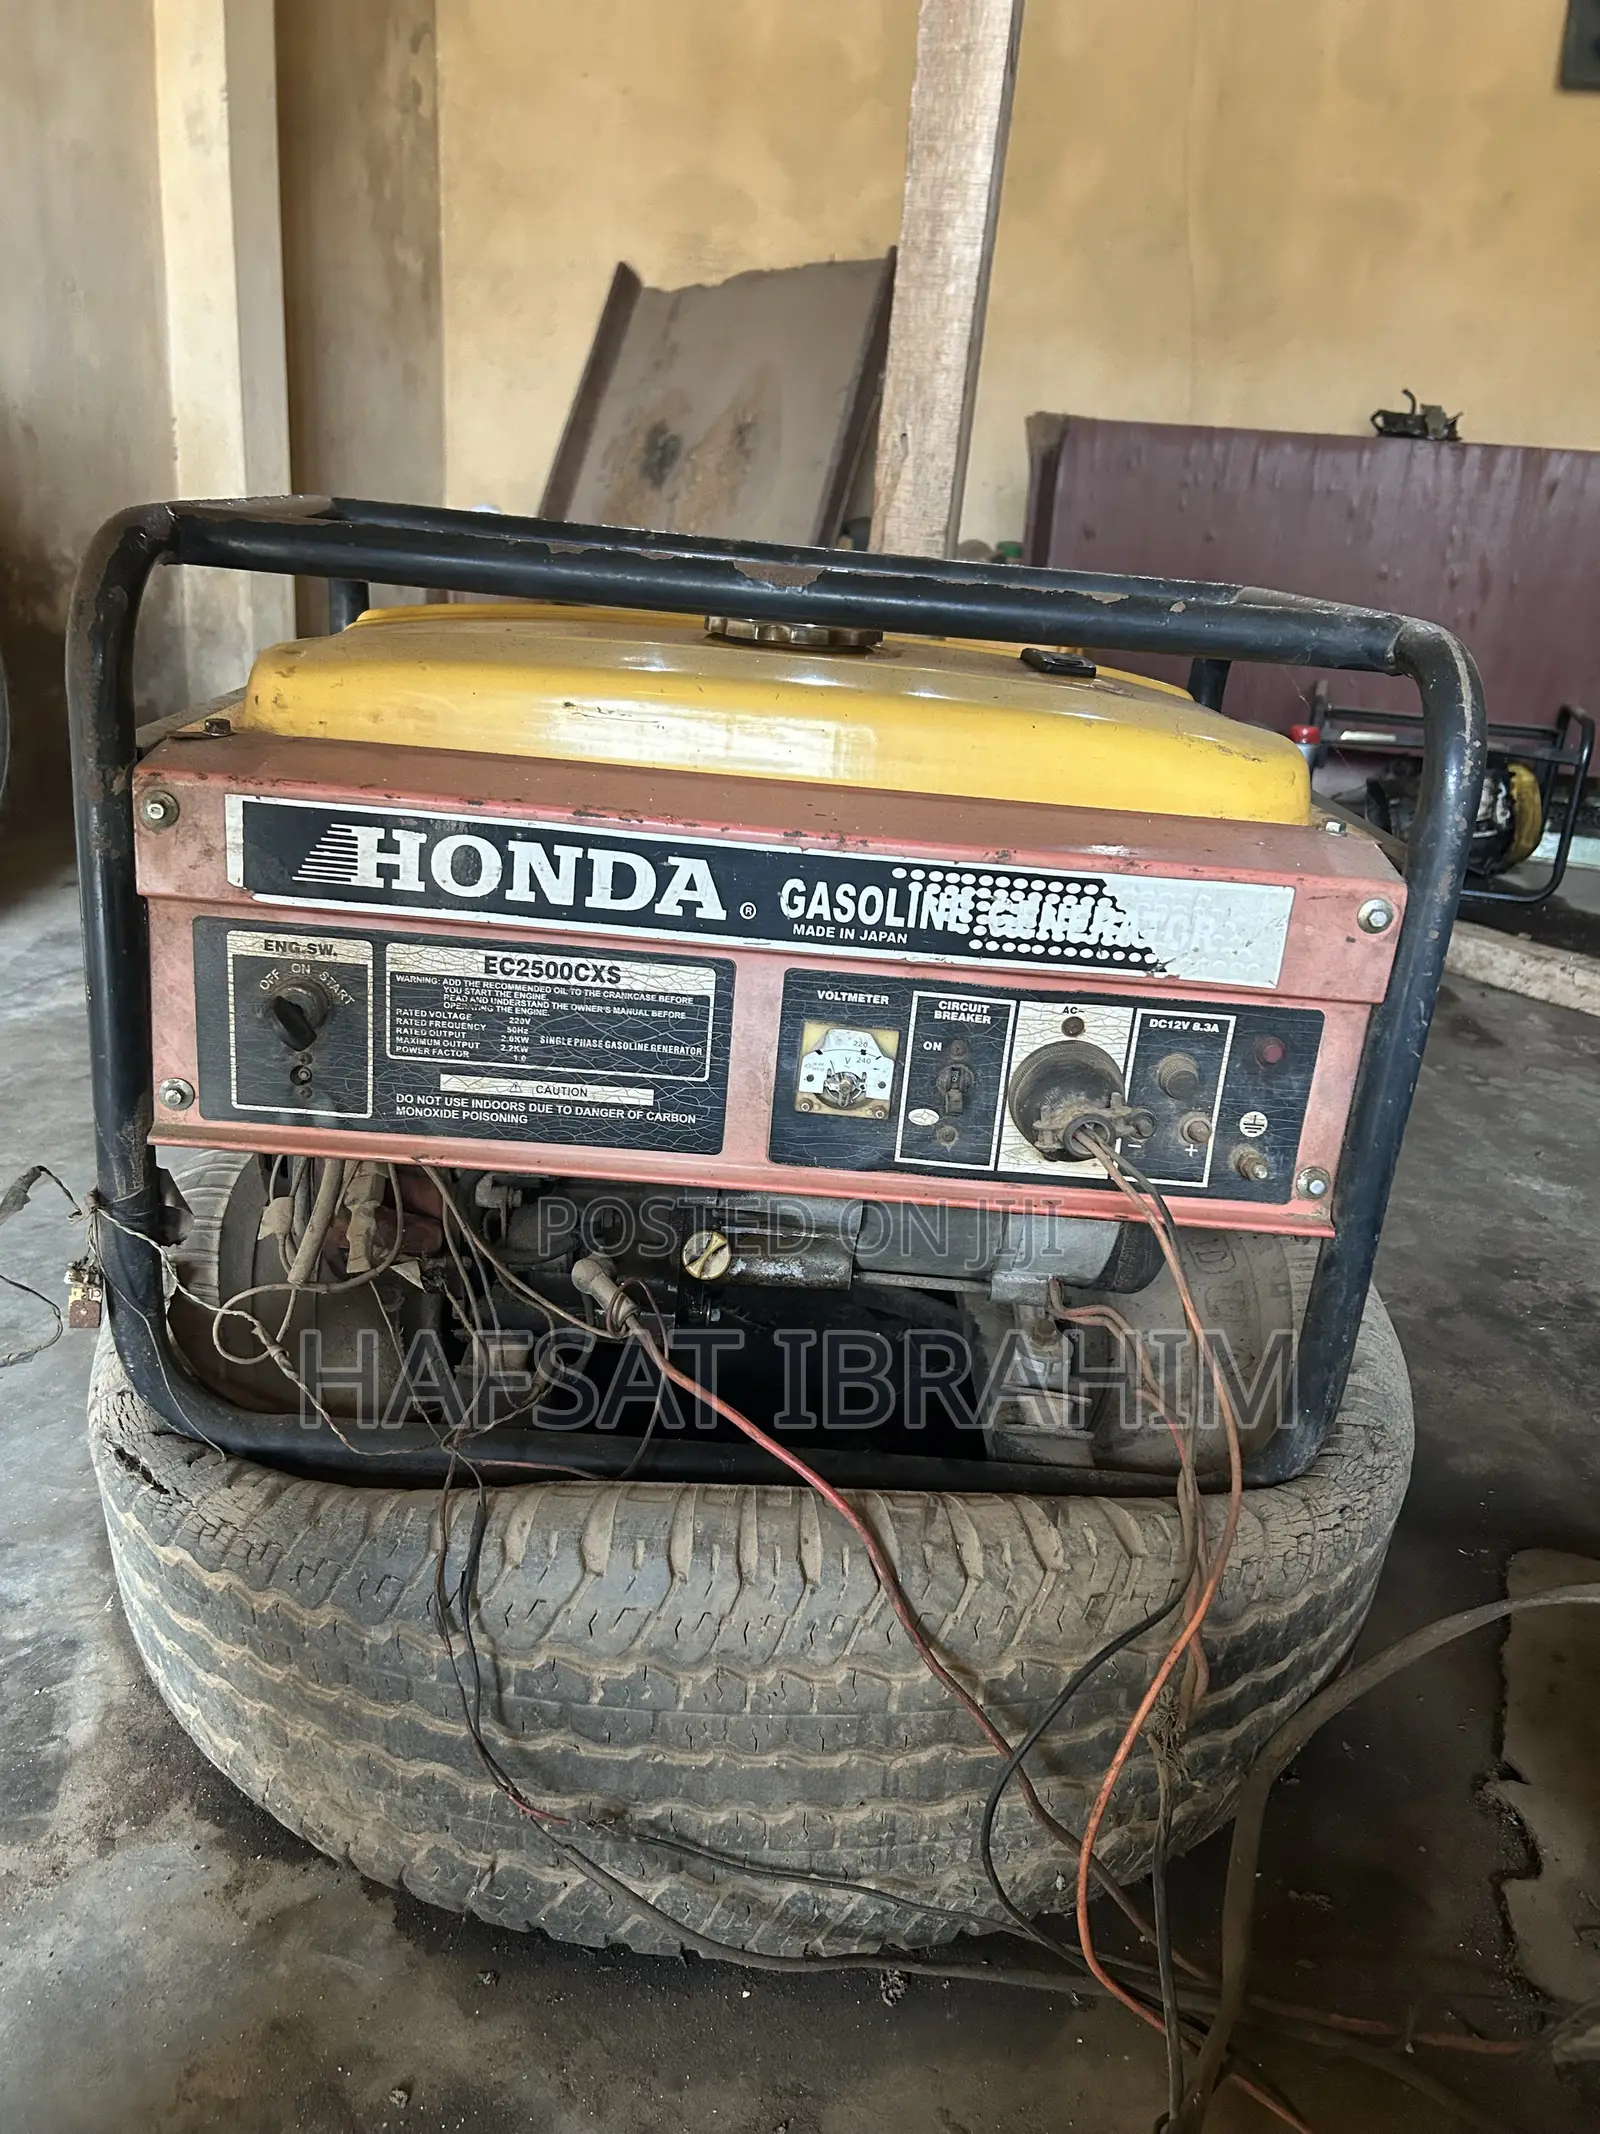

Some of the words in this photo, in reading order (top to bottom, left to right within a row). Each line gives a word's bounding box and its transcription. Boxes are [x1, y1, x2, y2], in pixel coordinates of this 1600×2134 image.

[346, 824, 727, 921] HONDA
[793, 924, 836, 939] MADE
[839, 928, 855, 940] IN
[860, 930, 908, 944] JAPAN
[484, 955, 621, 984] EC2500CXS
[260, 968, 281, 990] OFF
[291, 963, 311, 975] ON
[319, 971, 356, 1005] START
[396, 974, 441, 986] WARNING:
[442, 978, 462, 987] ADD
[464, 980, 480, 988] THE
[483, 981, 551, 993] RECOMMENDED
[553, 987, 568, 995] OIL
[570, 988, 582, 996] TO
[584, 989, 600, 997] THE
[603, 991, 657, 1001] CRANKCASE
[659, 995, 694, 1005] BEFORE
[444, 986, 462, 995] YOU
[464, 987, 493, 997] START
[494, 990, 512, 998] THE
[514, 991, 550, 1001] ENGINE.
[817, 990, 889, 1005] VOLTMETER
[443, 1002, 494, 1012] OPERATING
[495, 1005, 512, 1014] THE
[515, 1006, 550, 1016] ENGINE.
[444, 994, 467, 1003] READ
[470, 996, 488, 1005] AND
[491, 997, 550, 1009] UNDERSTAND
[552, 1002, 568, 1010] THE
[571, 1003, 611, 1013] OWNER'S
[613, 1006, 649, 1017] MANUAL
[651, 1010, 686, 1019] BEFORE
[938, 1001, 990, 1014] CIRCUIT
[396, 1008, 427, 1018] RATED
[429, 1010, 472, 1021] VOLTAGE
[509, 1017, 531, 1025] 220V
[934, 1010, 991, 1025] BREAKER
[396, 1018, 427, 1027] RATED
[429, 1020, 487, 1031] FREQUENCY
[507, 1026, 529, 1035] 50Hz
[396, 1027, 427, 1036] RATED
[429, 1029, 467, 1039] OUTPUT
[1149, 1018, 1190, 1031] DC12V
[1192, 1021, 1219, 1033] 8.3A
[396, 1036, 440, 1046] MAXIMUM
[442, 1040, 481, 1049] OUTPUT
[500, 1044, 529, 1053] 2.2KW
[396, 1046, 430, 1056] POWER
[432, 1048, 470, 1058] FACTOR
[540, 1035, 572, 1046] SINGLE
[574, 1038, 603, 1048] PHASE
[605, 1040, 649, 1051] GASOLINE
[651, 1044, 703, 1056] GENERATOR
[853, 1040, 868, 1048] 220
[923, 1041, 942, 1052] ON
[856, 1057, 871, 1065] 240
[535, 1085, 588, 1098] CAUTION
[396, 1094, 414, 1104] DO
[417, 1095, 442, 1106] NOT
[444, 1097, 469, 1108] USE
[472, 1099, 526, 1112] INDOORS
[528, 1103, 554, 1114] DUE
[556, 1105, 573, 1115] TO
[575, 1106, 625, 1119] DANGER
[627, 1110, 644, 1120] OF
[646, 1111, 696, 1124] CARBON
[396, 1106, 460, 1120] MONOXIDE
[462, 1111, 528, 1124] POISONING
